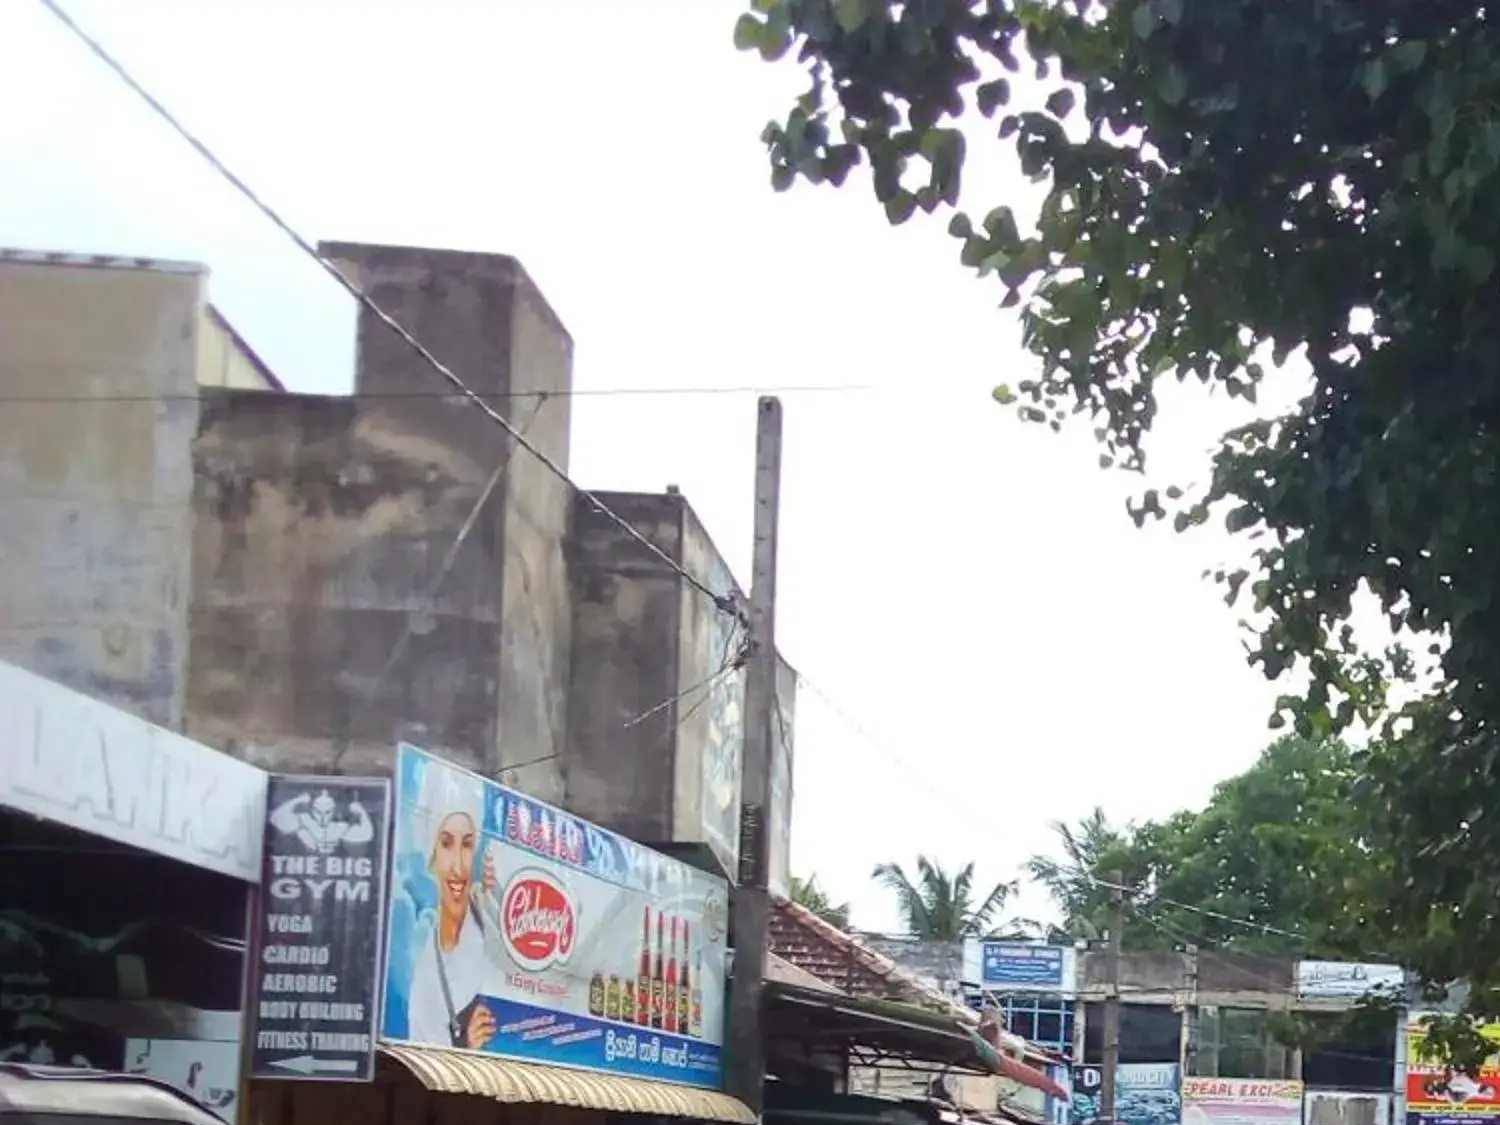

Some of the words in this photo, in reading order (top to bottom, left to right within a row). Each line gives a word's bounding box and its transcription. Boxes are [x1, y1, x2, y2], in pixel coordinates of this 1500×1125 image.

[271, 856, 320, 876] THE
[326, 856, 373, 877] BIG
[269, 879, 371, 902] GYM
[266, 913, 313, 933] YOGA
[262, 945, 330, 965] CARDIO
[262, 973, 338, 993] AEROBIC
[259, 1001, 298, 1019] BODY
[299, 1001, 365, 1021] BUILDING
[257, 1031, 308, 1050] FITNESS
[310, 1032, 370, 1052] TRAINING
